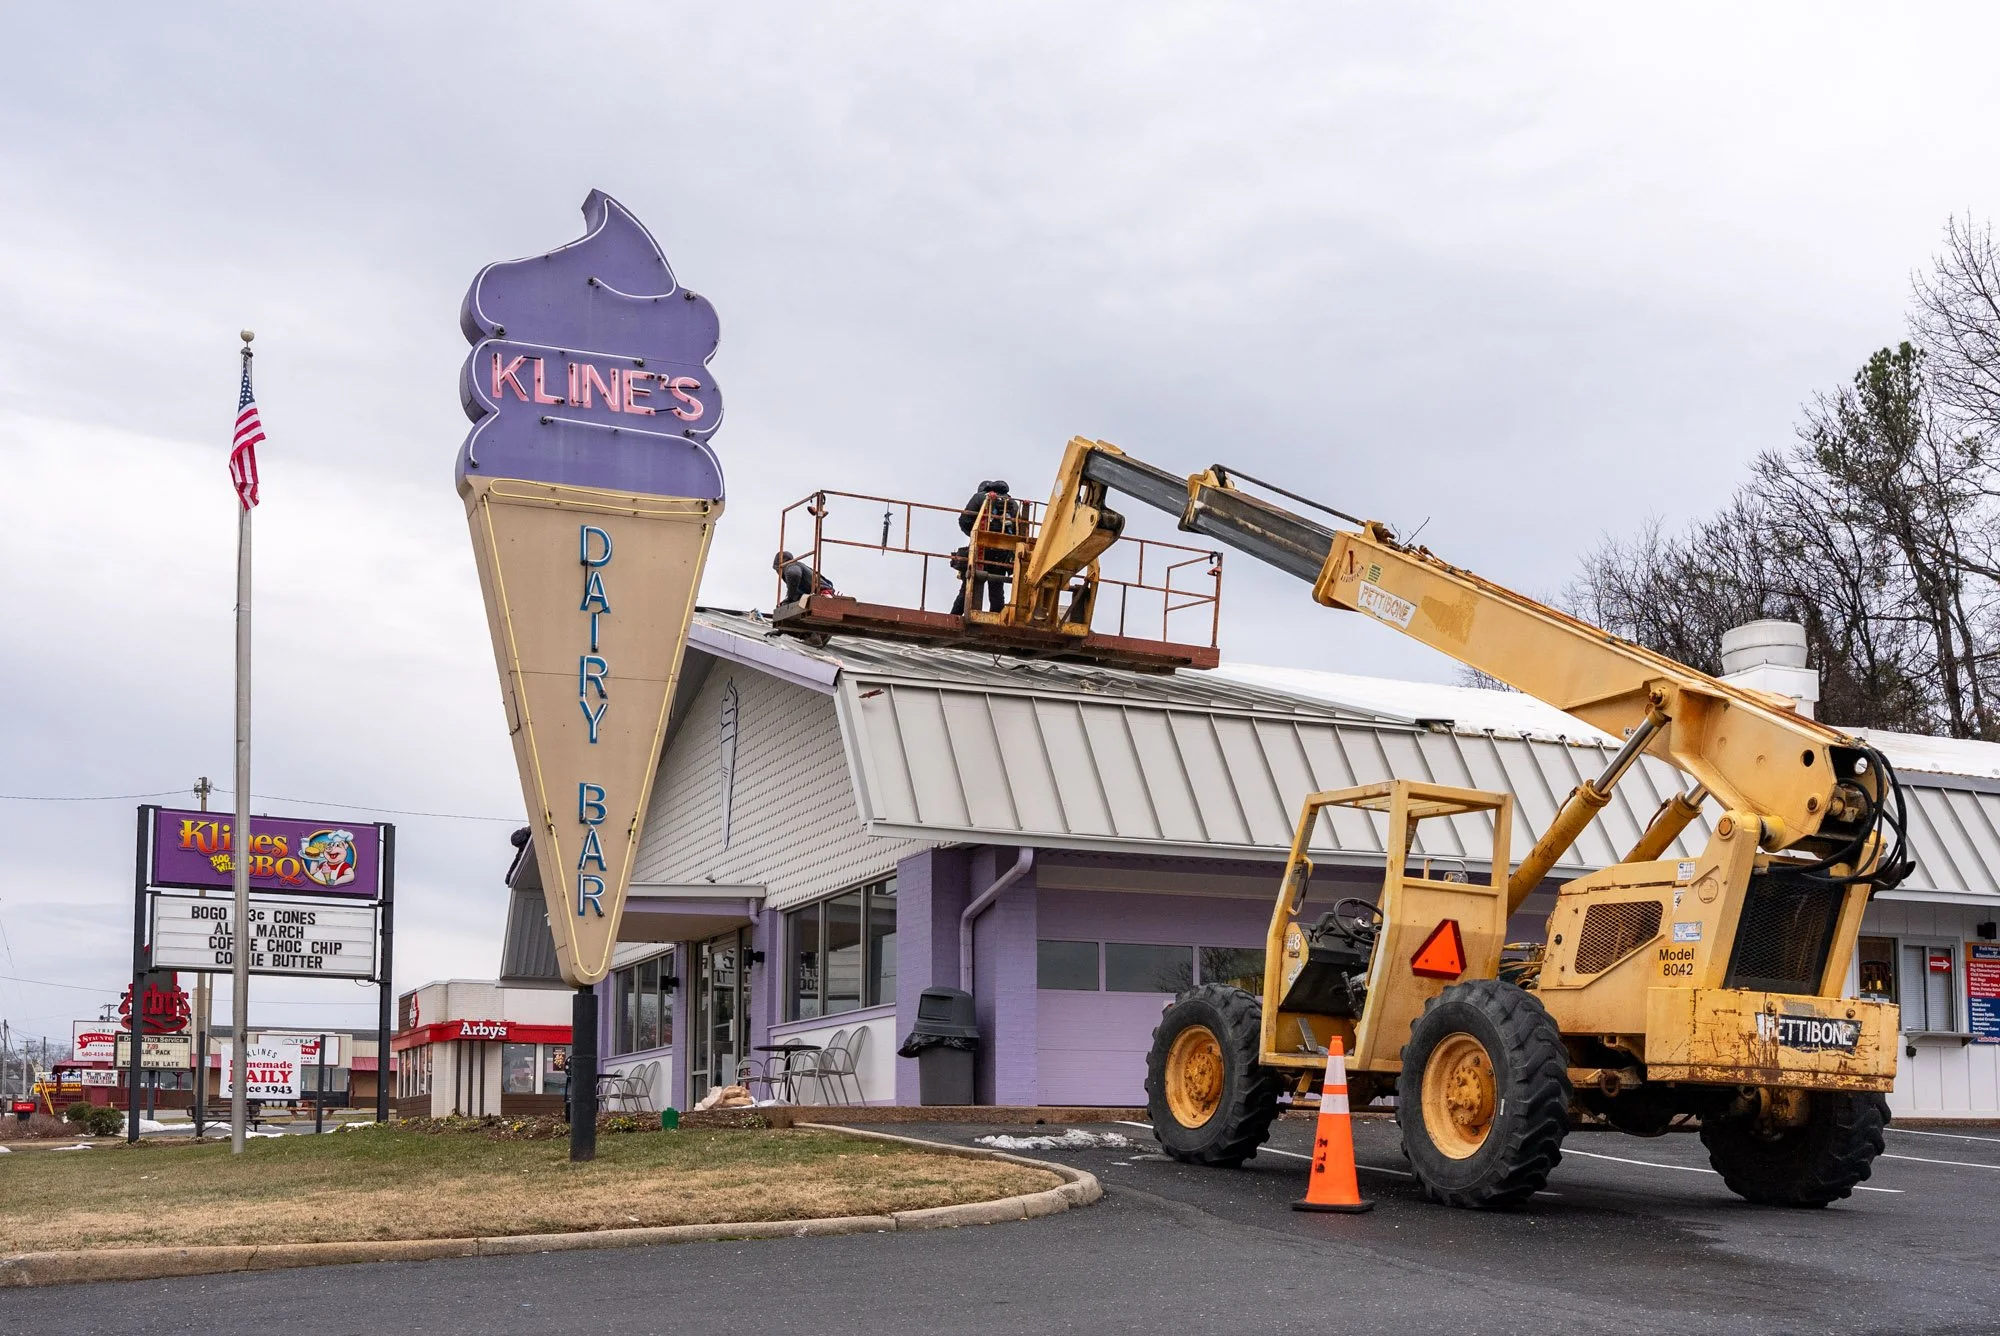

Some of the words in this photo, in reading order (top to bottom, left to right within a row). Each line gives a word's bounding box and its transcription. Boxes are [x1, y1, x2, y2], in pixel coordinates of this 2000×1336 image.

[492, 353, 704, 421] KLINE'S
[579, 525, 613, 743] DAIRY
[180, 820, 288, 858] Klies
[577, 782, 608, 917] BAR
[191, 906, 226, 919] BOGO
[274, 911, 315, 925] CONES
[214, 922, 233, 935] AL
[256, 924, 304, 939] MARCH
[208, 936, 258, 951] COFE
[267, 939, 302, 953] CHOC
[311, 942, 342, 955] CHIP
[1659, 948, 1695, 961] Model
[215, 951, 264, 966] COIE
[272, 954, 323, 969] BUTTER
[1663, 963, 1694, 976] 8042
[118, 983, 191, 1022] Arby's
[82, 1034, 115, 1043] STAUNTO
[460, 1022, 507, 1039] Arby's
[228, 1070, 293, 1083] AILY
[227, 1083, 262, 1093] Sce
[264, 1085, 293, 1094] 1943
